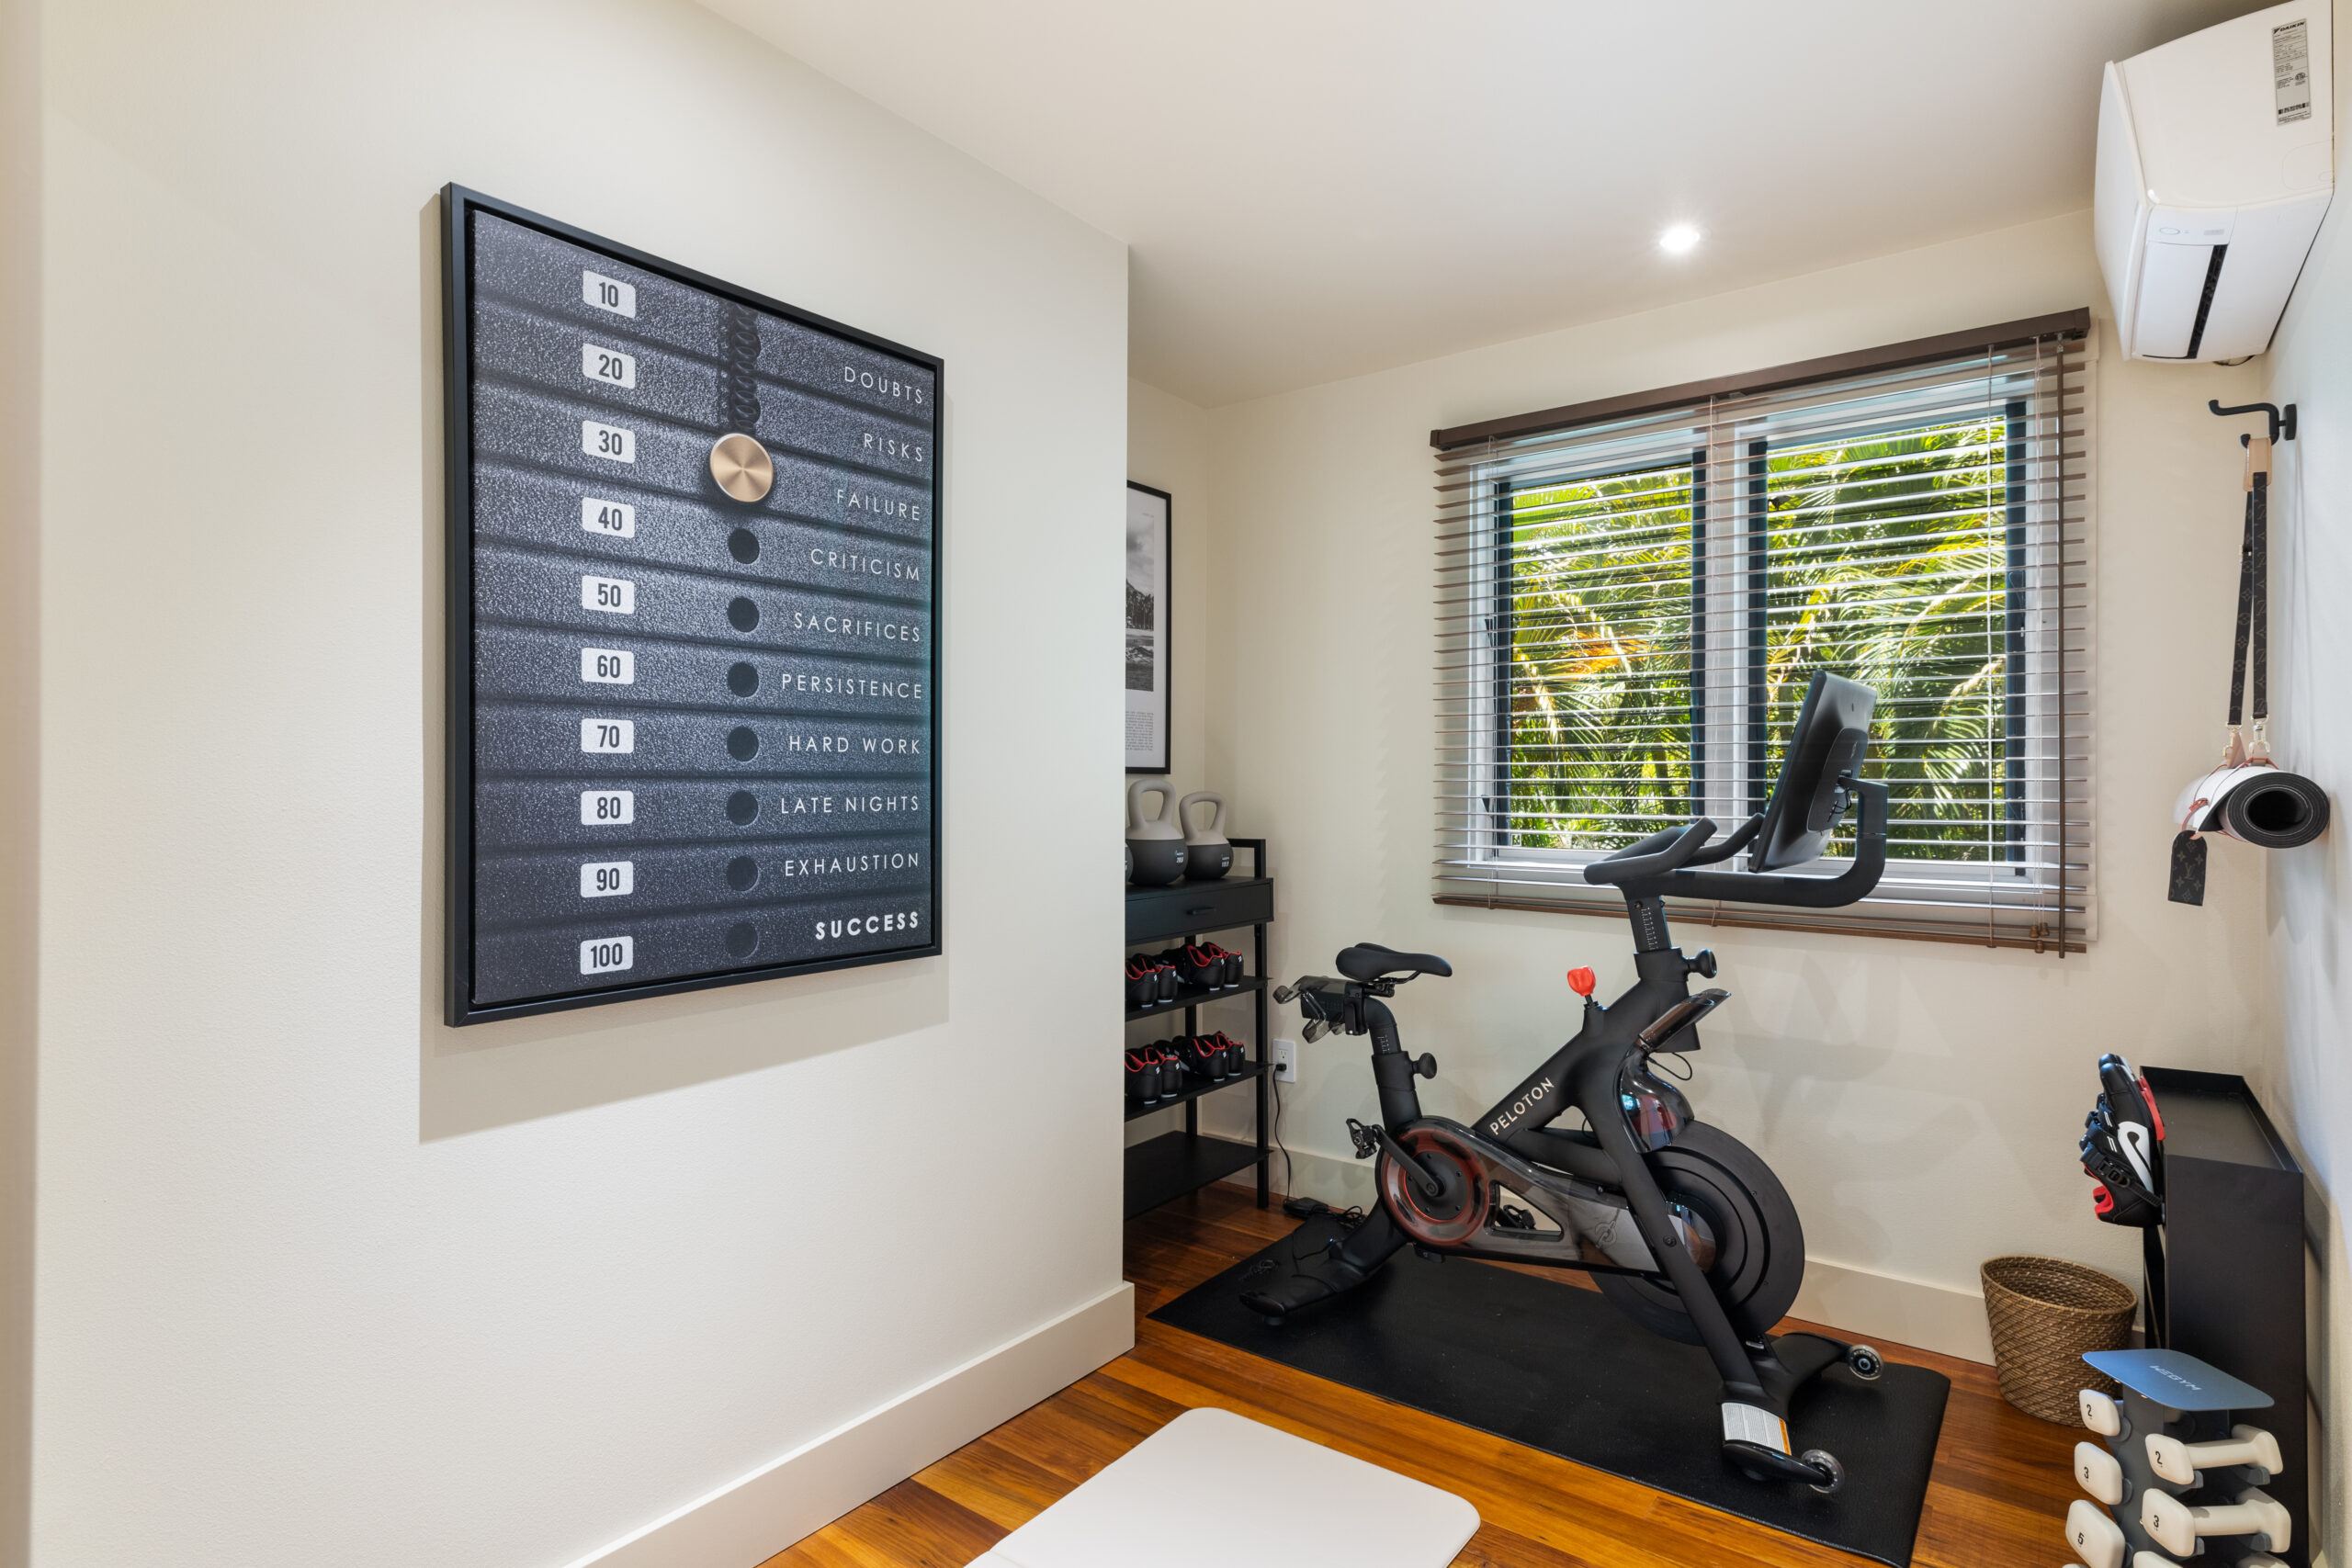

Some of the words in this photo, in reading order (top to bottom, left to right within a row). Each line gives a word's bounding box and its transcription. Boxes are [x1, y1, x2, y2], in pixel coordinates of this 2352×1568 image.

[2280, 22, 2304, 31] DAIKIN
[599, 282, 618, 308] 10
[598, 354, 623, 380] 20
[844, 366, 922, 404] DOUBTS
[598, 430, 622, 456] 30
[864, 433, 922, 462] RISKS
[837, 489, 920, 521] FAILURE
[598, 506, 622, 531] 40
[810, 548, 920, 581] CRITICISM
[597, 583, 621, 607] 50
[794, 612, 920, 642] SACRIFICES
[597, 654, 621, 679] 60
[782, 673, 922, 699] PERSISTENCE
[597, 725, 620, 749] 70
[789, 735, 849, 752] HARD
[862, 738, 920, 754] WORK
[596, 796, 621, 819] 80
[781, 797, 832, 814] LATE
[845, 795, 918, 812] NIGHTS
[785, 852, 918, 876] EXHAUSTION
[596, 867, 620, 892] 90
[815, 911, 918, 941] SUCCESS
[590, 942, 623, 968] 100
[1489, 1077, 1555, 1135] PELOTON
[2149, 1365, 2202, 1391] WEGYM
[2086, 1404, 2093, 1417] 2
[2154, 1450, 2163, 1465] 2
[2084, 1466, 2089, 1479] 3
[2153, 1515, 2160, 1529] 3
[2077, 1532, 2085, 1545] 5
